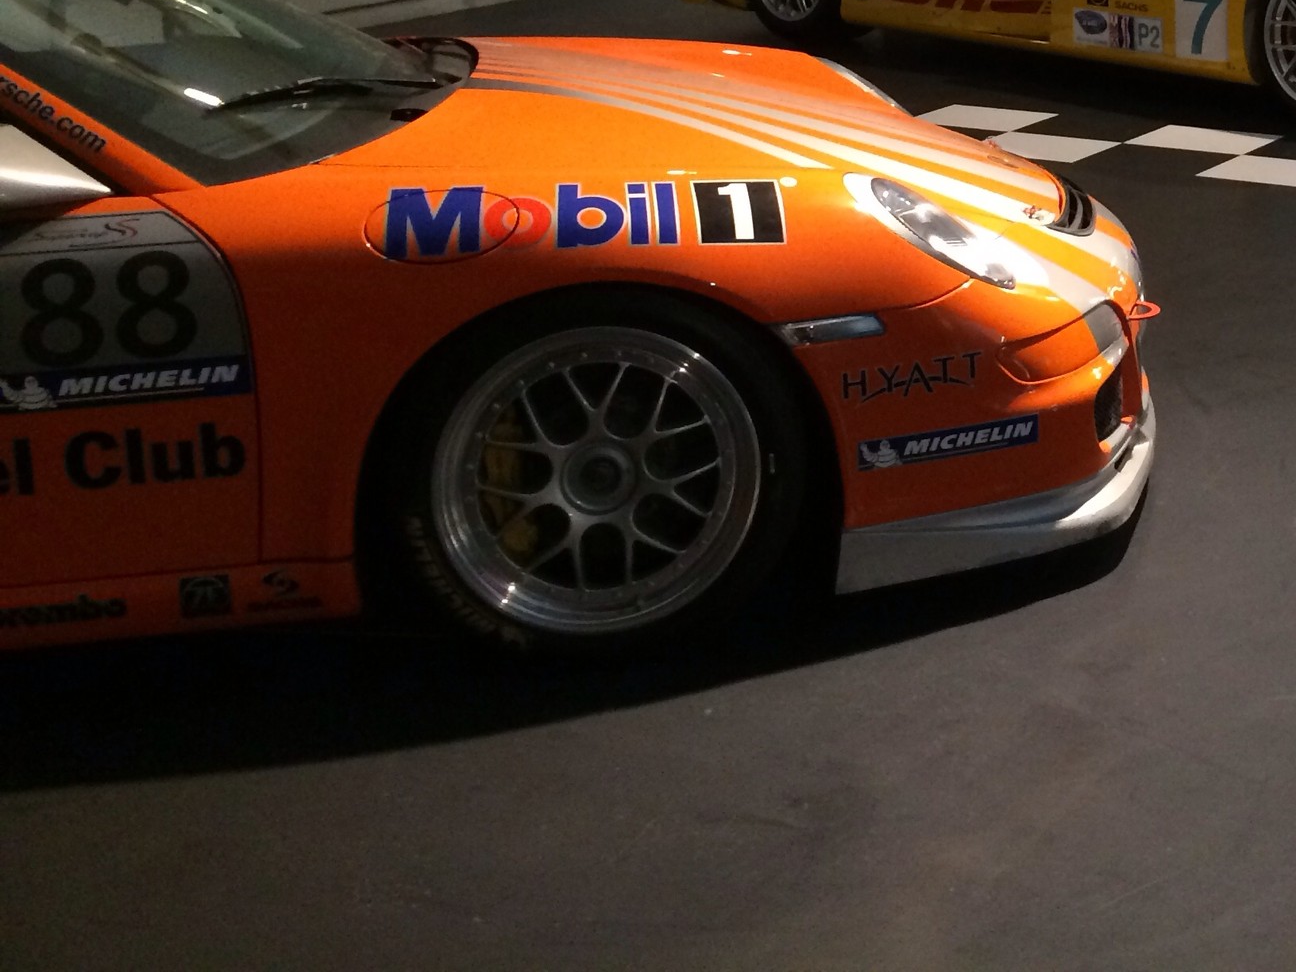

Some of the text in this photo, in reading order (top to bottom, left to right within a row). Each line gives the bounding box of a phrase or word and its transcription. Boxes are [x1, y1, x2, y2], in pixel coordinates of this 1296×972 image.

[1114, 0, 1149, 12] SACHS
[1138, 22, 1160, 49] P2
[385, 181, 679, 260] Mobil
[20, 250, 199, 368] 88
[58, 364, 240, 397] MICHELIN
[842, 351, 982, 401] HYATT
[64, 422, 246, 490] Club
[903, 420, 1034, 457] MICHELIN
